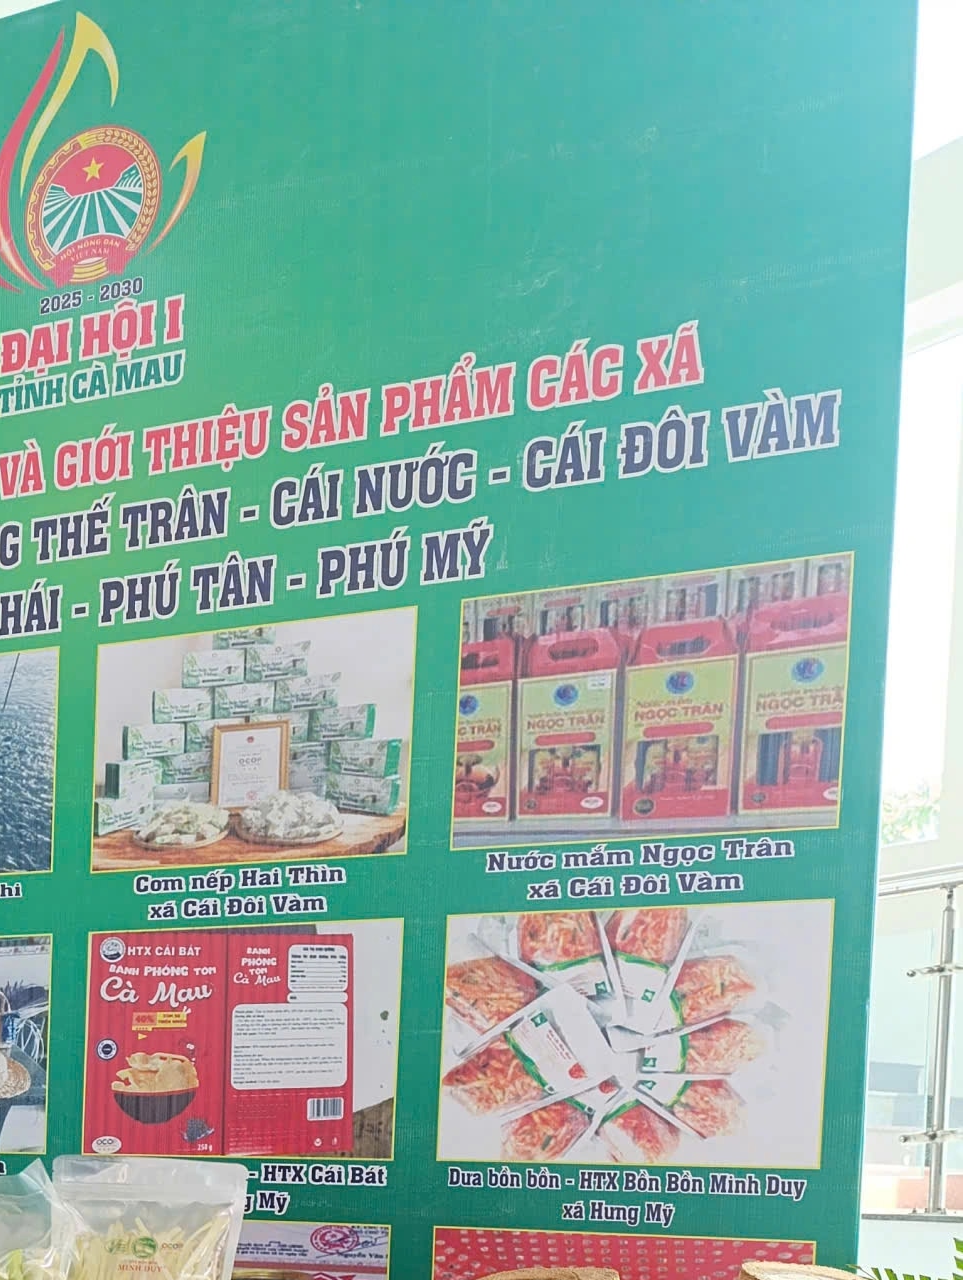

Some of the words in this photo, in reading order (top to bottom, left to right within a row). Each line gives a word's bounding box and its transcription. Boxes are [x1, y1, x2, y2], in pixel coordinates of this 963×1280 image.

[39, 290, 82, 315] 2025
[99, 277, 144, 302] 2030
[0, 320, 71, 375] ĐẠI
[80, 299, 155, 359] HỘI
[165, 297, 183, 341] I
[71, 363, 107, 401] CÀ
[115, 352, 184, 393] MAU
[55, 425, 133, 489] GIỚI
[144, 405, 270, 472] THIỆU
[283, 385, 369, 451] SẢN
[382, 353, 514, 434] PHẨM
[529, 340, 623, 410] CÁC
[636, 322, 703, 393] XÃ
[33, 494, 111, 562] THẾ
[121, 486, 229, 549] TRÂN
[271, 465, 342, 527] CÁI
[355, 442, 476, 514] NƯỚC
[523, 422, 606, 490] CÁI
[619, 408, 708, 476] ĐÔI
[724, 390, 839, 459] VÀM
[99, 565, 181, 625] PHÚ
[192, 553, 275, 612] TÂN
[318, 528, 408, 597] PHÚ
[422, 518, 492, 583] MỸ
[487, 852, 554, 871] Nước
[563, 844, 632, 867] mắm
[641, 843, 714, 867] Ngọc
[723, 839, 793, 861] Trân
[191, 870, 234, 894] nếp
[240, 868, 280, 887] Hai
[288, 865, 345, 884] Thìn
[527, 881, 560, 899] xã
[568, 877, 613, 897] Cái
[622, 875, 670, 895] Đôi
[677, 872, 742, 893] Vàm
[149, 902, 175, 919] xã
[182, 899, 220, 917] Cái
[226, 895, 266, 915] Đôi
[271, 894, 326, 913] Vàm
[127, 946, 152, 956] HTX
[155, 944, 175, 956] CÁI
[178, 944, 202, 956] BÁT
[99, 976, 140, 1003] Cà
[147, 981, 213, 1008] Mau
[262, 1164, 305, 1182] HTX
[310, 1165, 344, 1184] Cái
[350, 1166, 386, 1185] Bát
[487, 1166, 521, 1188] bồn
[526, 1167, 561, 1189] bồn
[579, 1171, 619, 1190] HTX
[623, 1169, 661, 1192] Bồn
[665, 1170, 704, 1193] Bồn
[709, 1173, 760, 1195] Minh
[765, 1175, 806, 1200] Duy
[258, 1192, 288, 1214] Mỹ
[562, 1202, 584, 1220] xã
[645, 1203, 676, 1227] Mỹ
